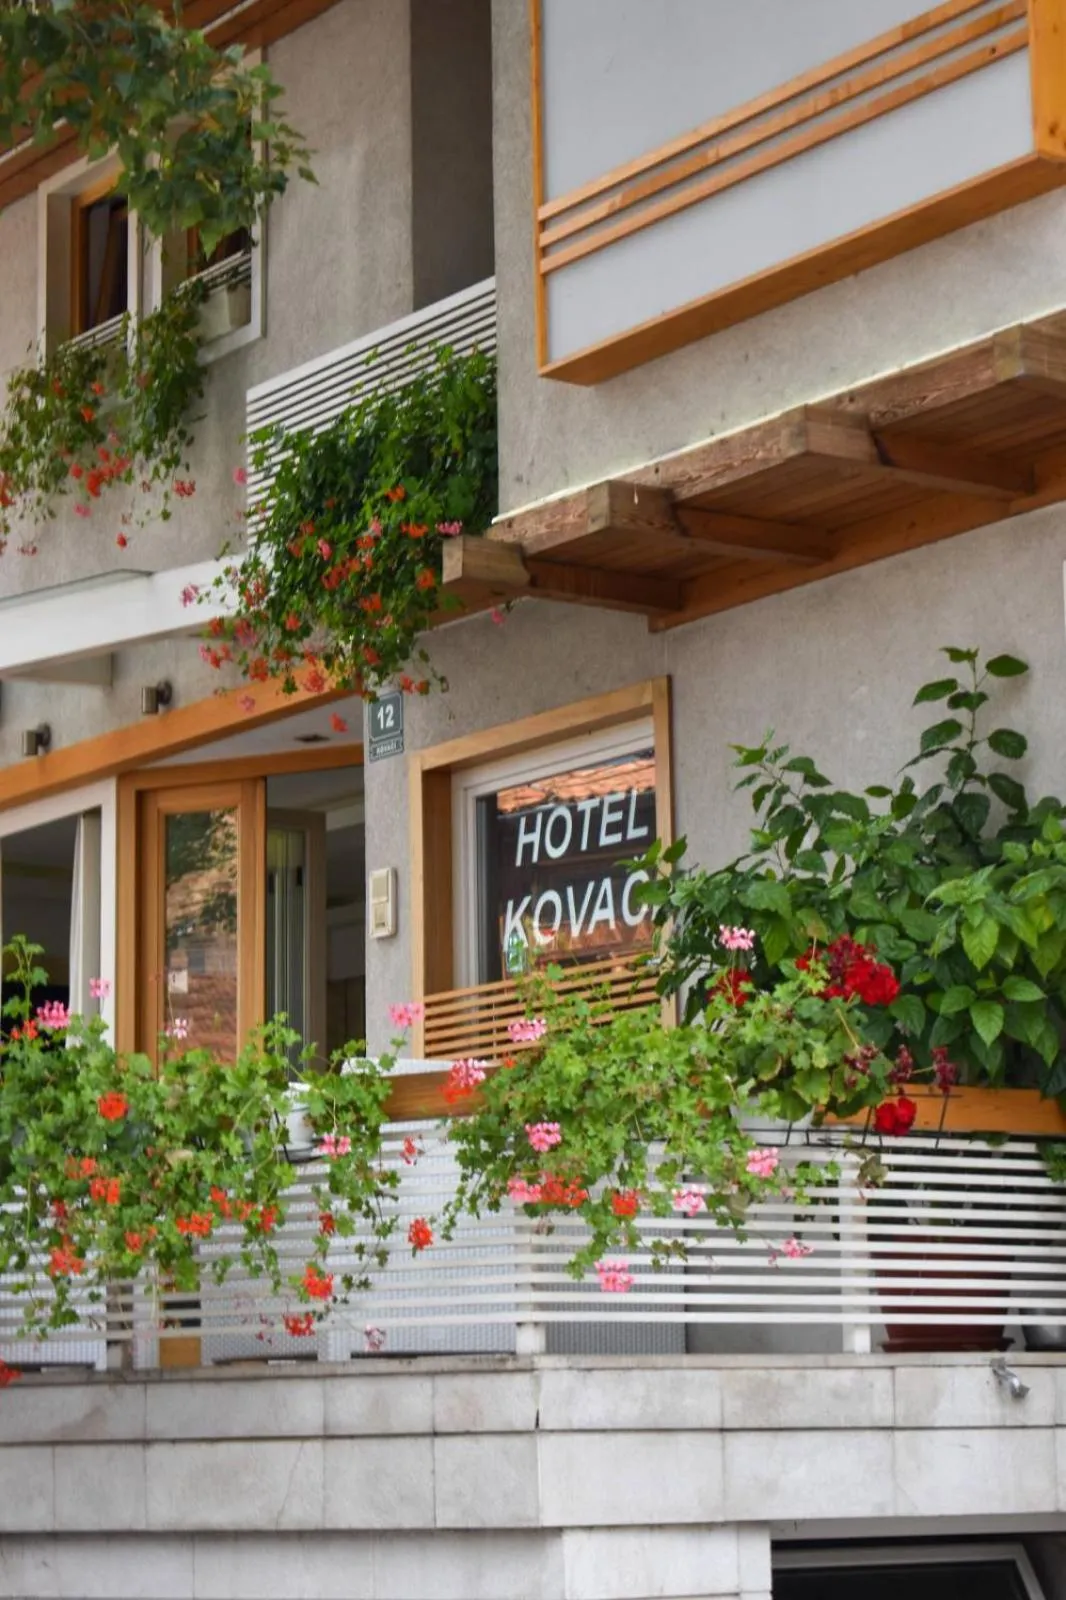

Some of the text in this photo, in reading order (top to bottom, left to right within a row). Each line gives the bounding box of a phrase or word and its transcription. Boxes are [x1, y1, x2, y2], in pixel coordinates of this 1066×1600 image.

[377, 704, 395, 730] 12
[515, 788, 649, 867] HOTEL
[503, 855, 659, 952] KOVAČ
